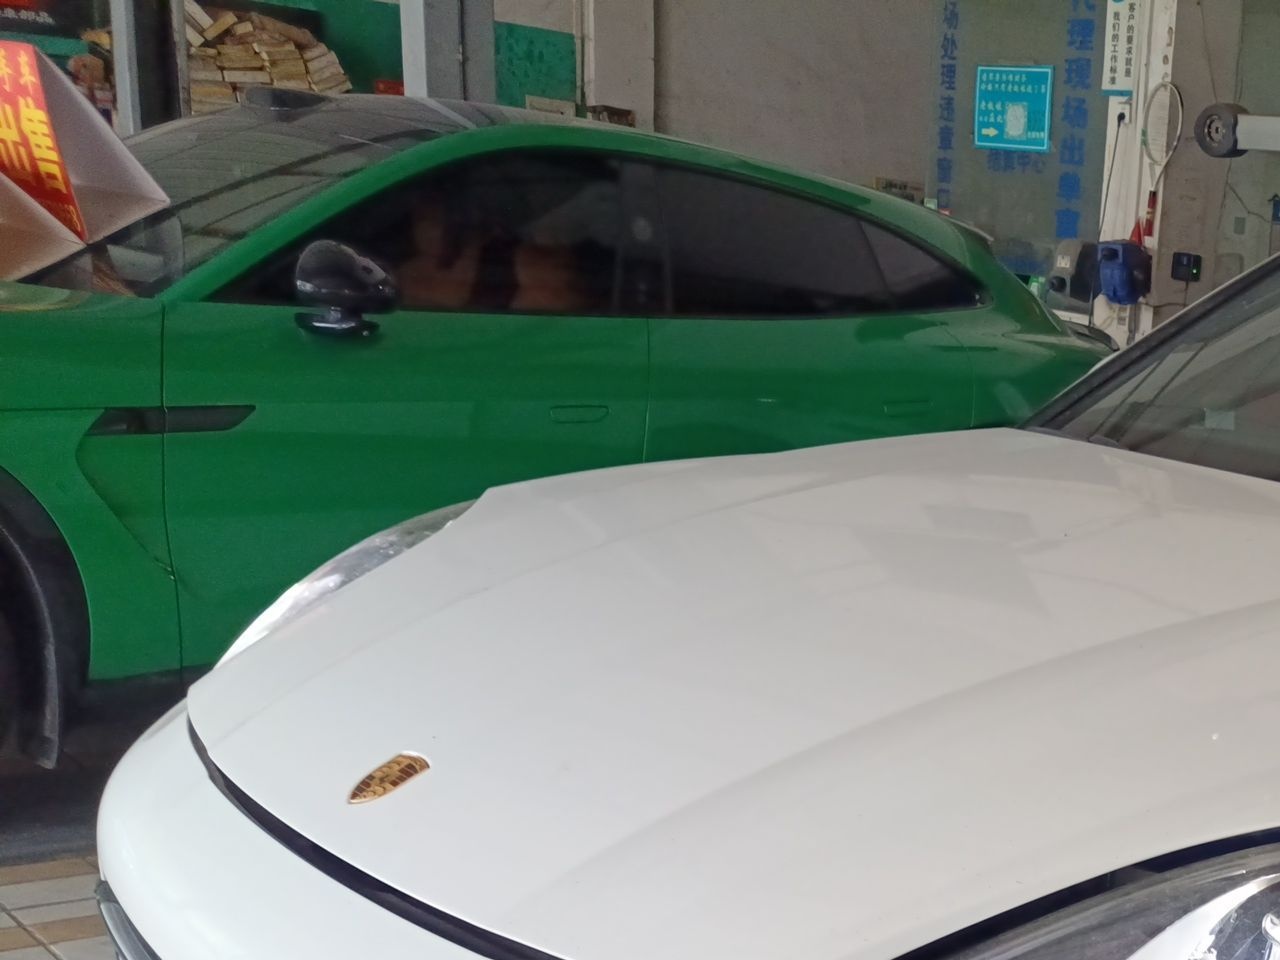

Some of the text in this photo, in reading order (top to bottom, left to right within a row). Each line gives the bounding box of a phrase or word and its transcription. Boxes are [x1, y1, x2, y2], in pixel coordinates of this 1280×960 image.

[1108, 11, 1121, 85] 我们的工作标准
[1124, 2, 1136, 78] 客户的要求就是
